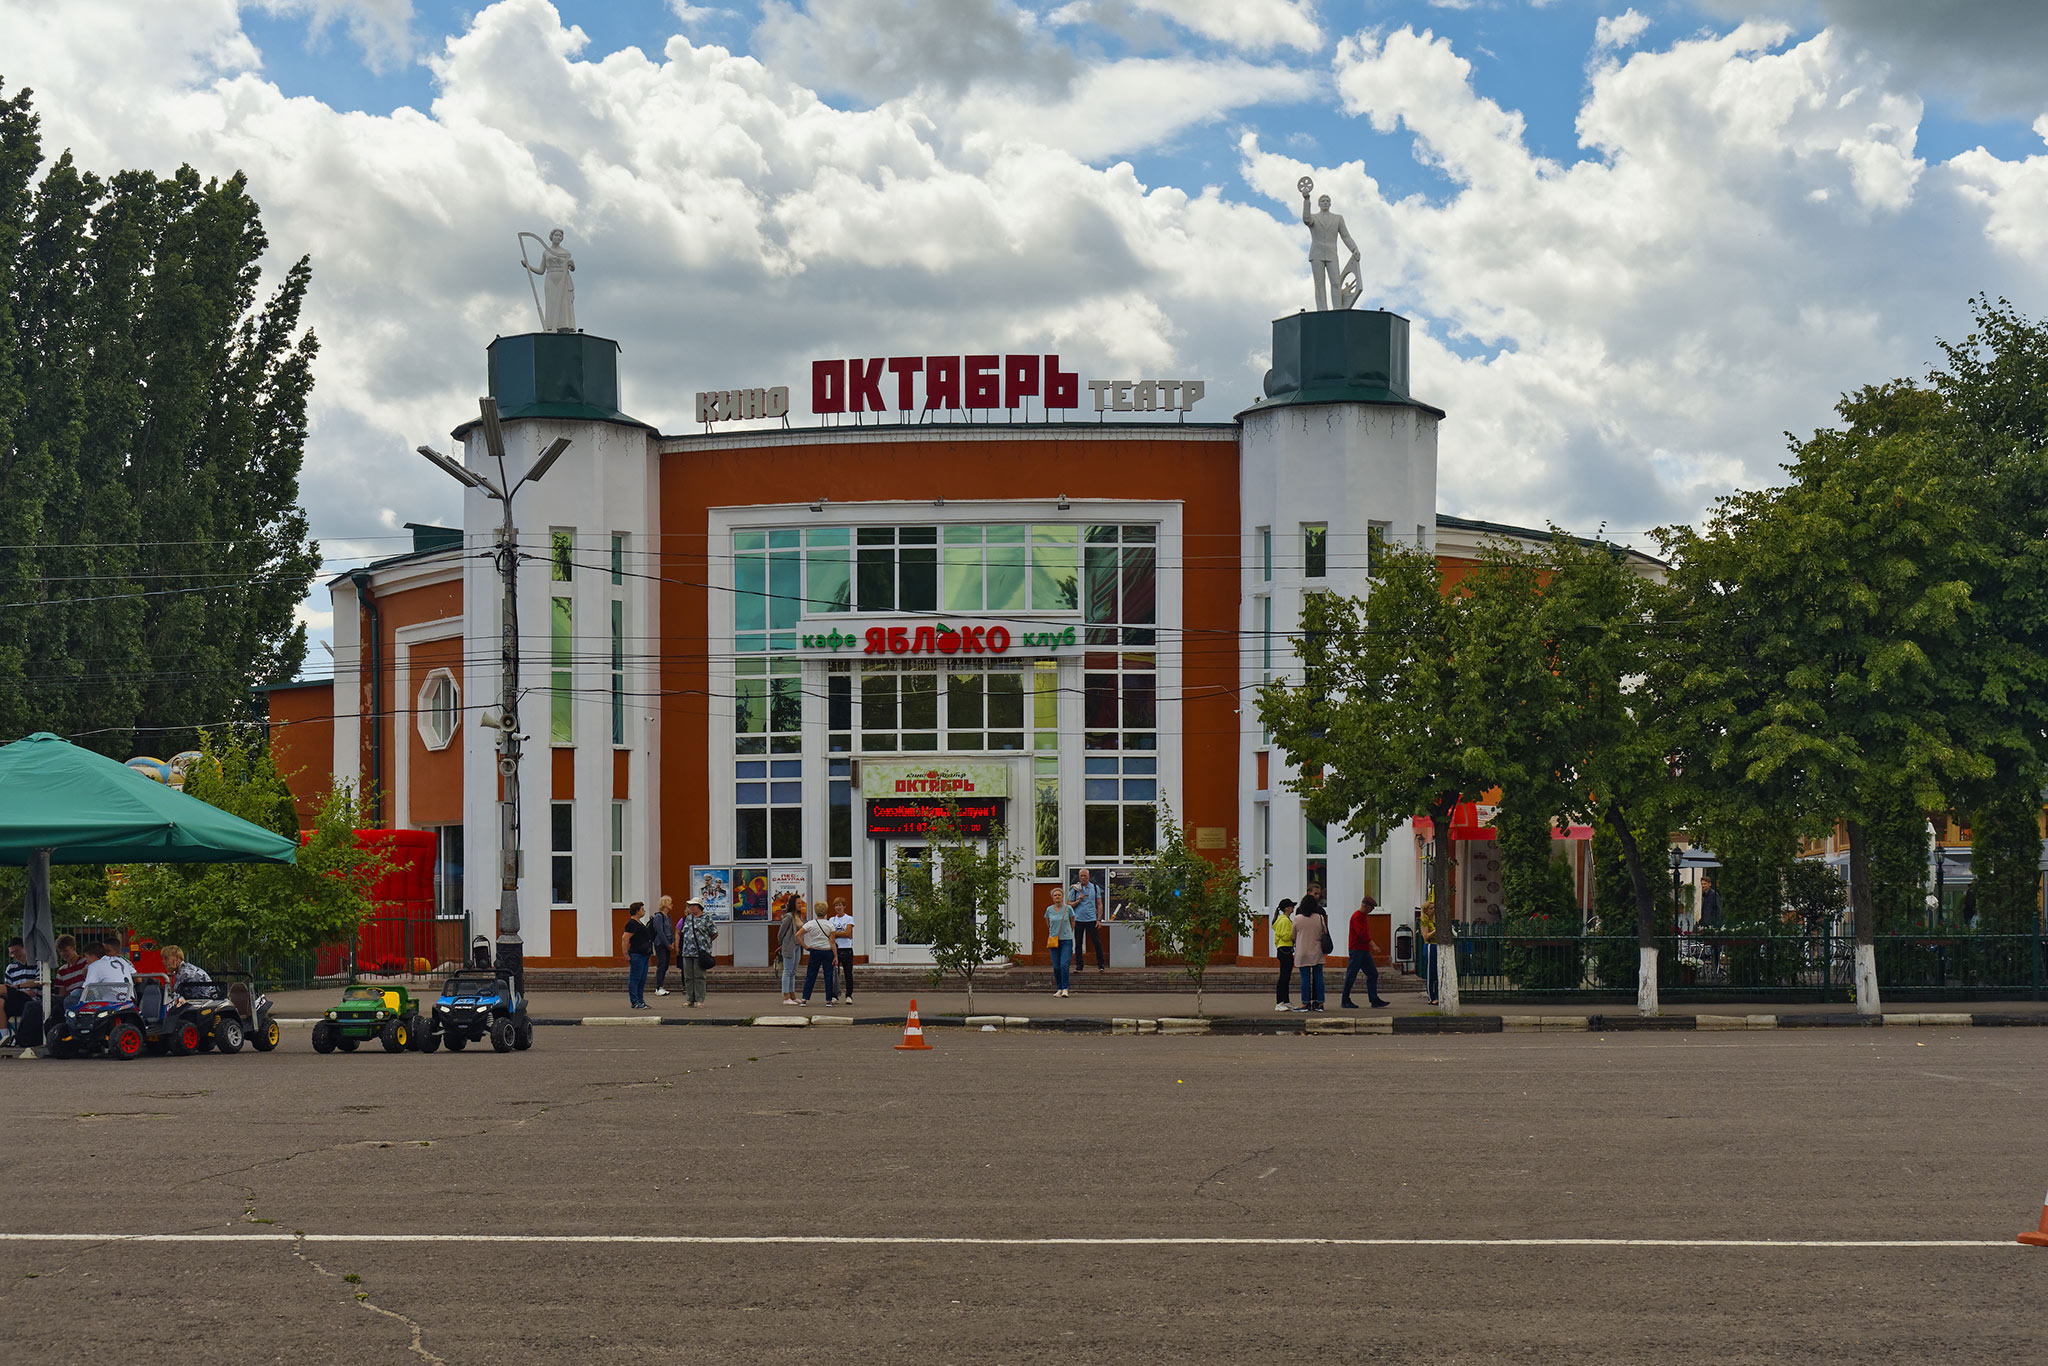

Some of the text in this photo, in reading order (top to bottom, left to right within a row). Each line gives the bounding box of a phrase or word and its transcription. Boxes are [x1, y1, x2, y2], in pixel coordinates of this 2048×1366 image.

[695, 354, 1205, 423] КИНО ОКТЯБРЬ ТЕАТР
[802, 622, 1076, 655] кафе ЯБЛОКО клуб
[895, 779, 975, 793] ОКТЯБРЬ
